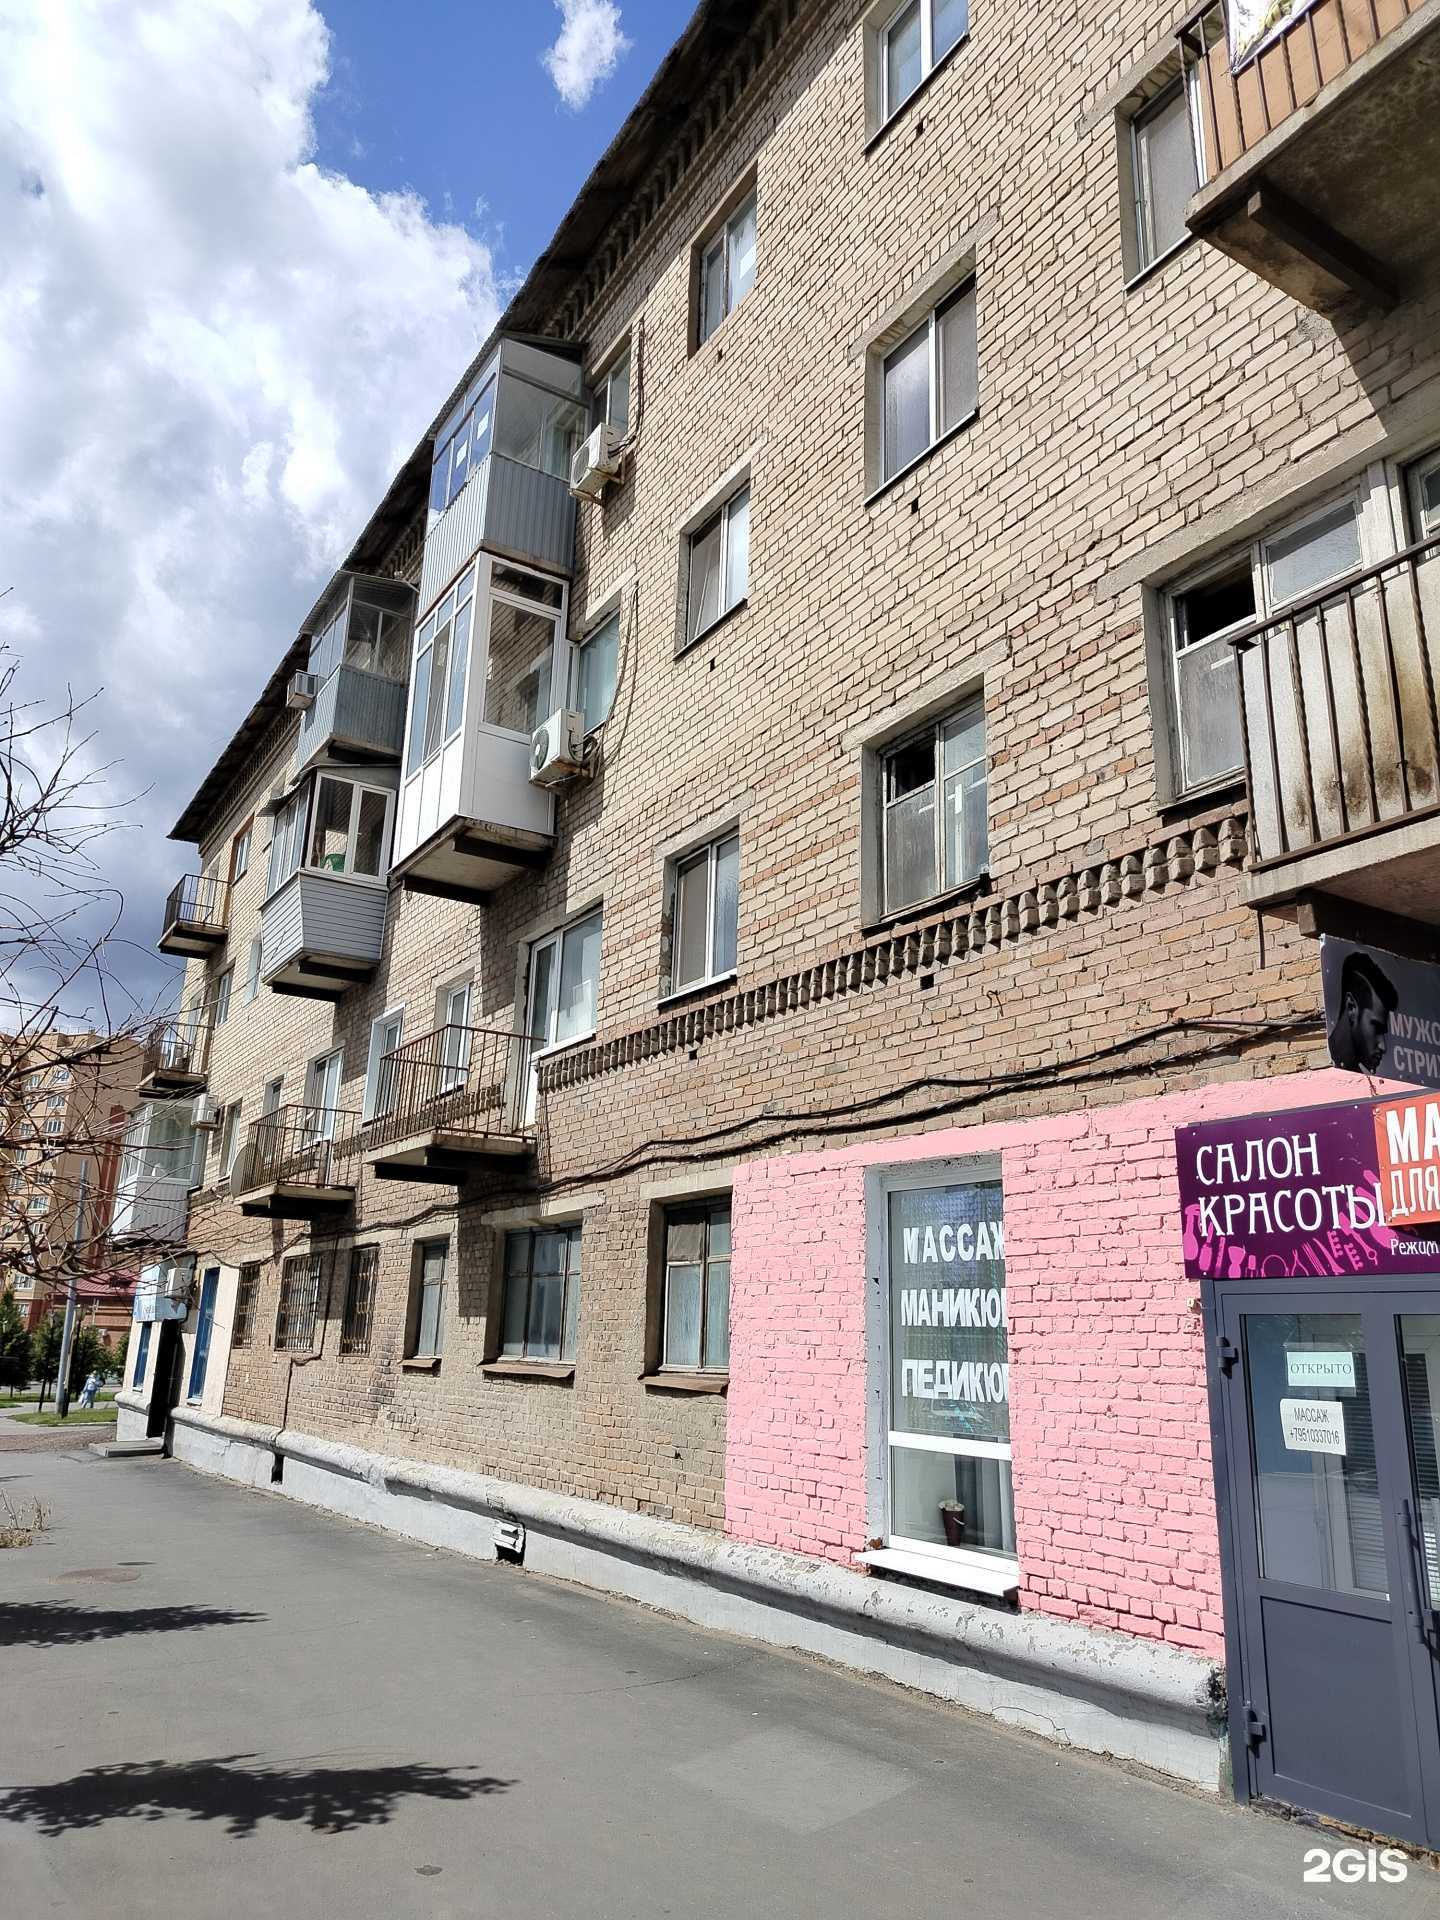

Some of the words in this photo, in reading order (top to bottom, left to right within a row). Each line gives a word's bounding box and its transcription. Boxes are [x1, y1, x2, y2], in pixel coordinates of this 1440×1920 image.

[1196, 1133, 1320, 1186] САЛОН
[1391, 1165, 1440, 1217] ДЛЯ
[1198, 1182, 1387, 1237] КРАСОТЫ
[1390, 1238, 1440, 1257] Режим
[1290, 1363, 1352, 1375] ОТКРЫТО
[1293, 1407, 1330, 1423] МАССАЖ
